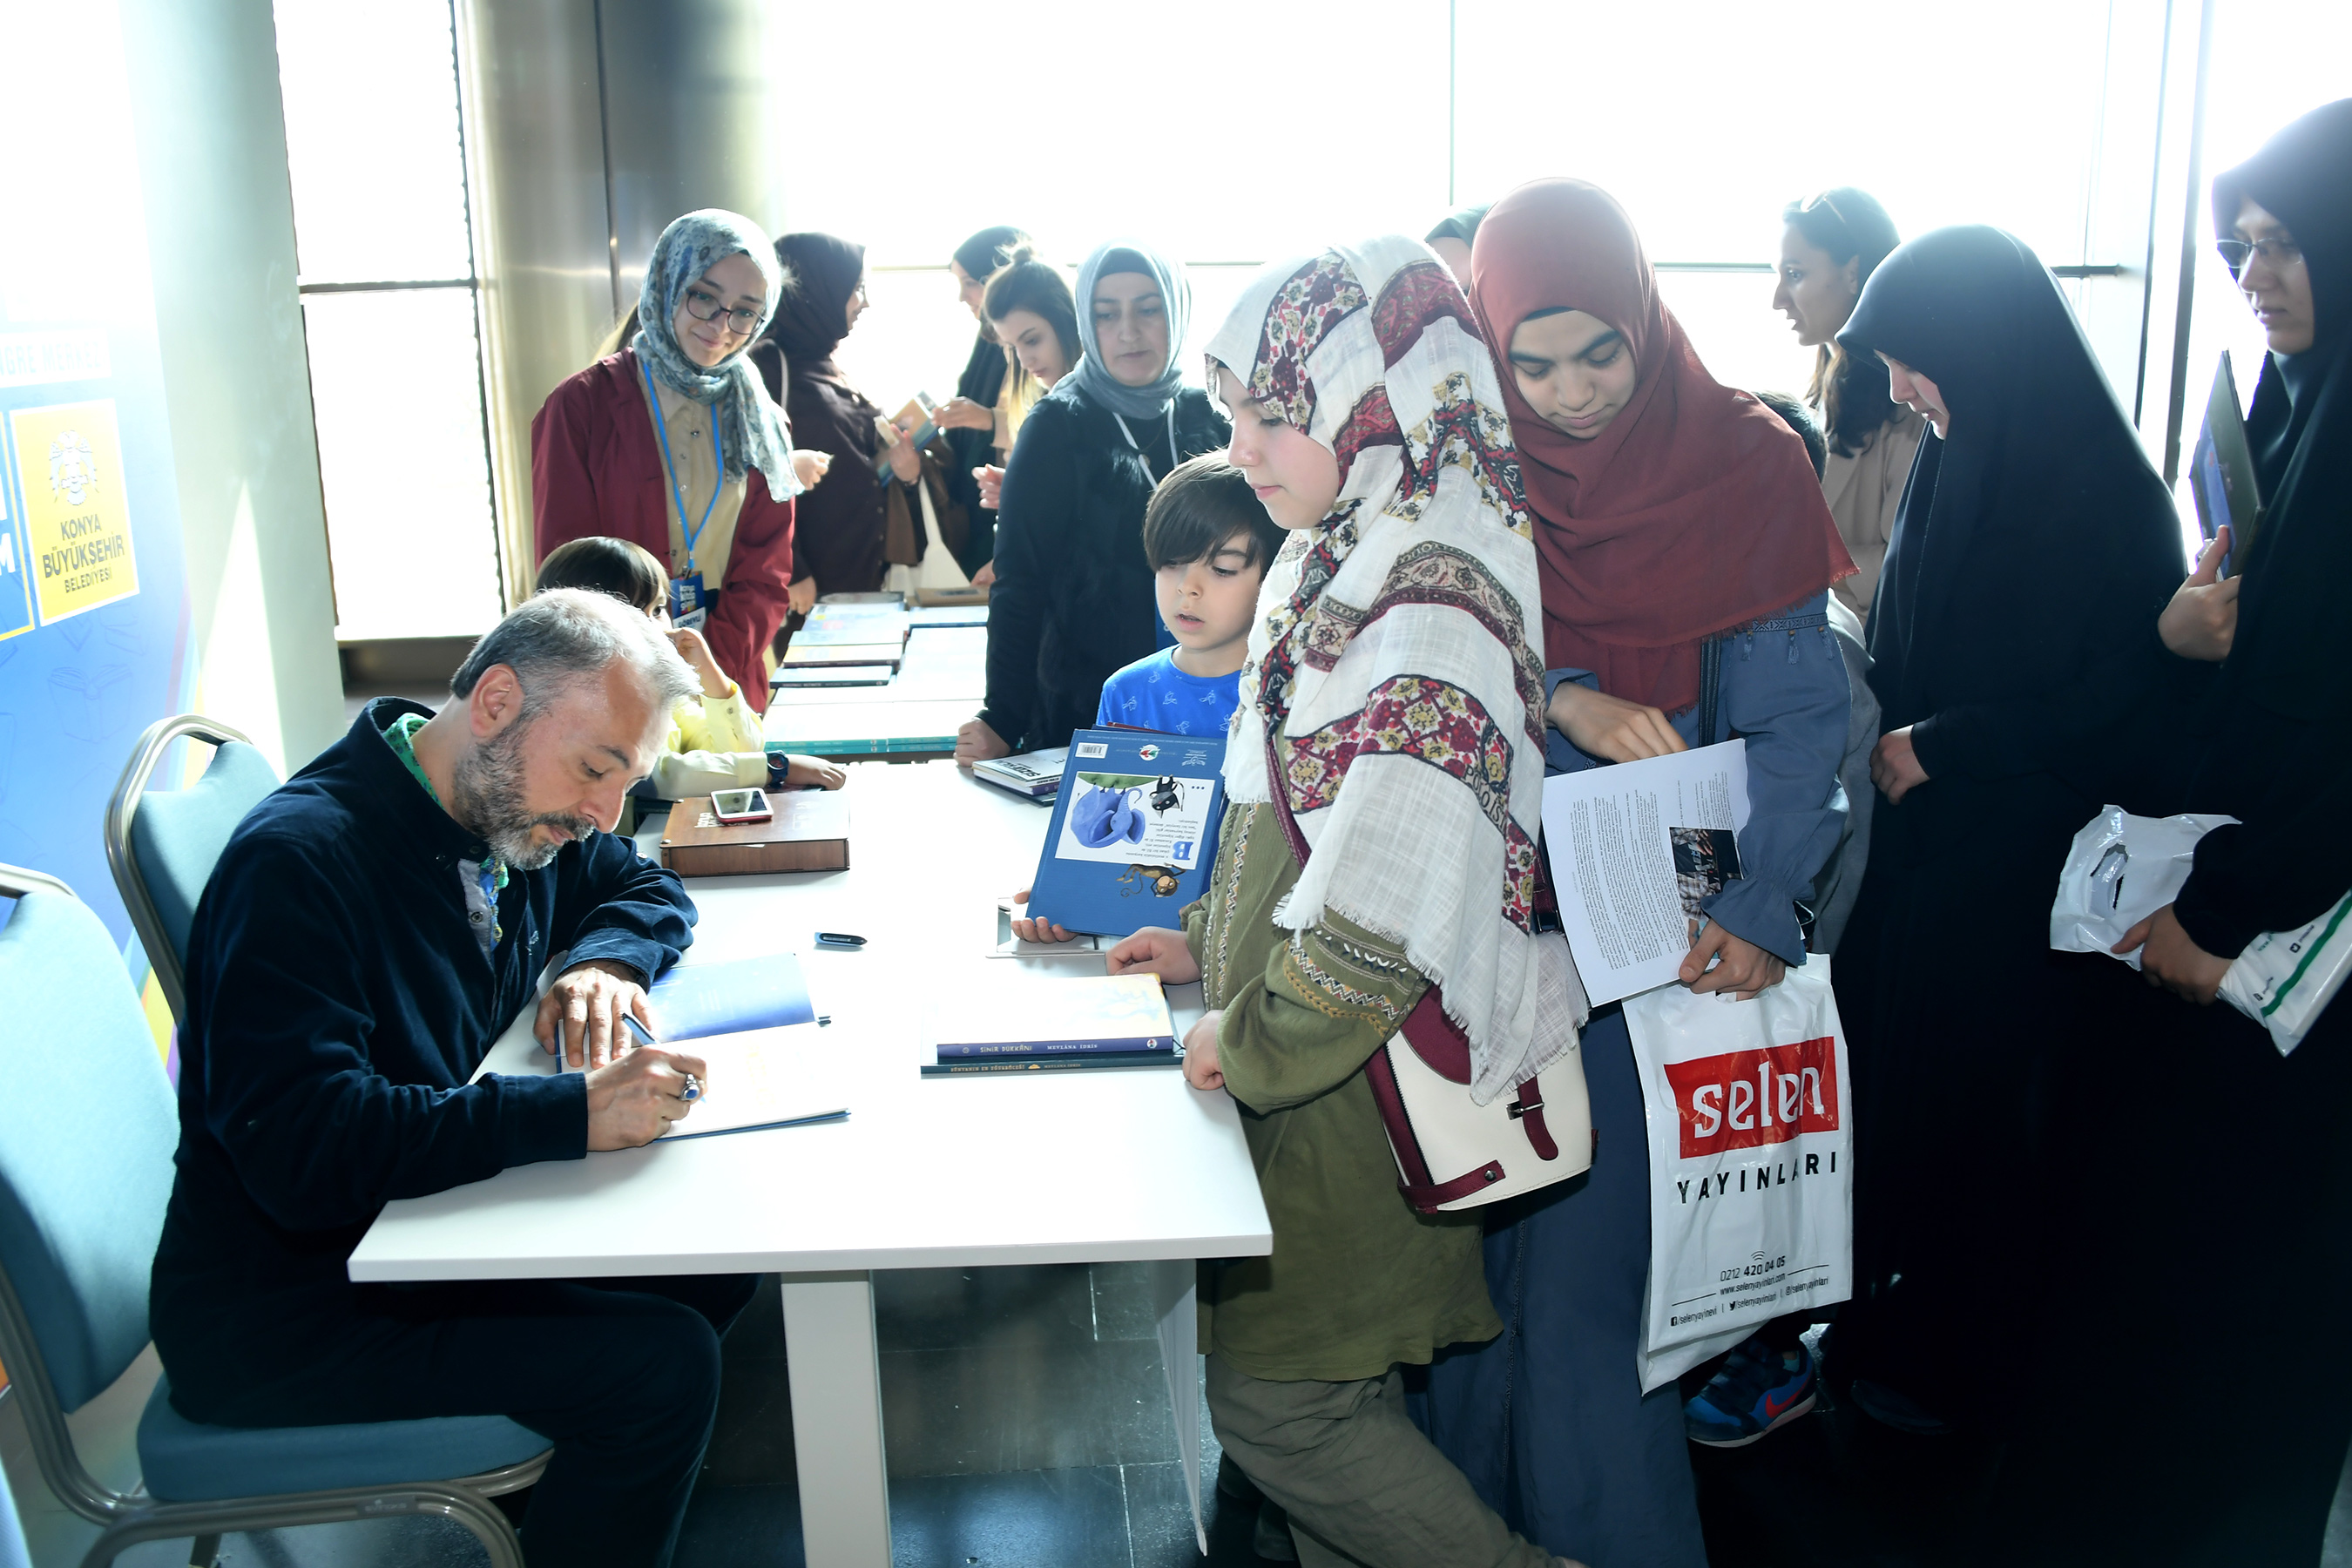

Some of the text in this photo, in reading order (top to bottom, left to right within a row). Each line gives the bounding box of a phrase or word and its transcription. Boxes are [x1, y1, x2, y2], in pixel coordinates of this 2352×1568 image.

[60, 514, 102, 541] KONYA
[43, 531, 125, 578] BÜYÜKŞEHİR
[64, 564, 112, 593] BELEDİYESİ
[1693, 1061, 1825, 1139] selen
[1677, 1152, 1836, 1204] YAYINLARI
[1720, 1255, 1786, 1281] 0212 420 04 05
[1720, 1273, 1786, 1295] www.selenyayinlari.com
